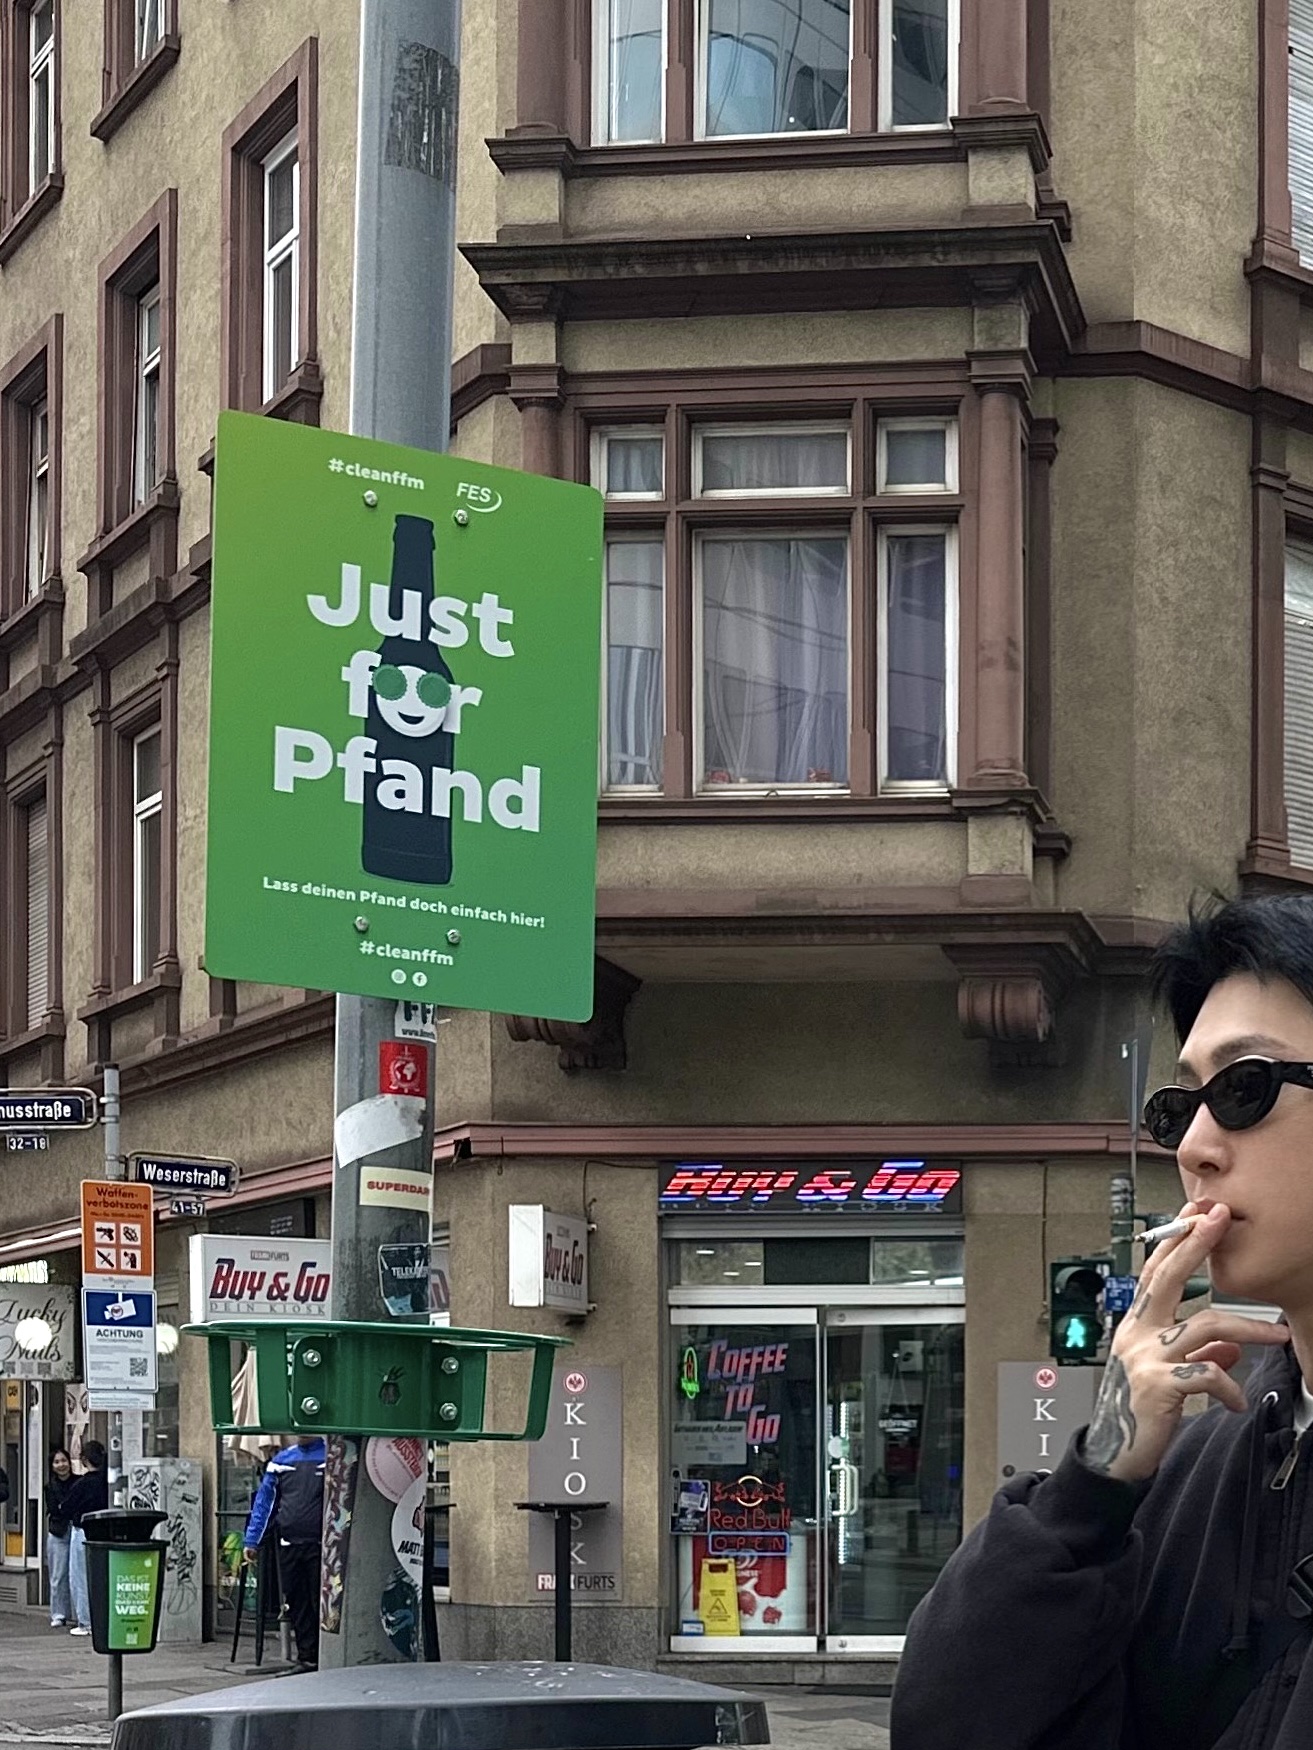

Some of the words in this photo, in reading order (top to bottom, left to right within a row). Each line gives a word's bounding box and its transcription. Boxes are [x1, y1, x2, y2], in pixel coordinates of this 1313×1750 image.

[328, 457, 424, 491] #cleanffm
[456, 481, 492, 504] FES
[307, 563, 515, 657] Just
[341, 650, 482, 738] for
[273, 725, 542, 833] Pfand
[263, 876, 298, 894] Lass
[301, 881, 357, 902] deinen
[359, 889, 407, 909] Pfand
[409, 896, 448, 915] doch
[450, 902, 507, 924] einfach
[509, 911, 546, 928] hier!
[359, 939, 454, 966] #cleanffm
[143, 1163, 226, 1187] Weserstraße
[86, 1197, 149, 1211] verbotszone
[96, 1187, 139, 1199] Waffen-
[171, 1201, 204, 1216] 41-57
[266, 1272, 291, 1301] &
[210, 1302, 255, 1313] DEIN
[269, 1303, 326, 1316] KIOSK
[96, 1328, 144, 1338] ACHTUNG
[1033, 1399, 1058, 1474] KI
[711, 1508, 747, 1529] Red
[752, 1508, 791, 1529] Bull
[714, 1537, 785, 1551] OPEN
[117, 1583, 150, 1592] KEINE
[537, 1573, 616, 1591] FRFURTS
[115, 1605, 149, 1615] WEG.
